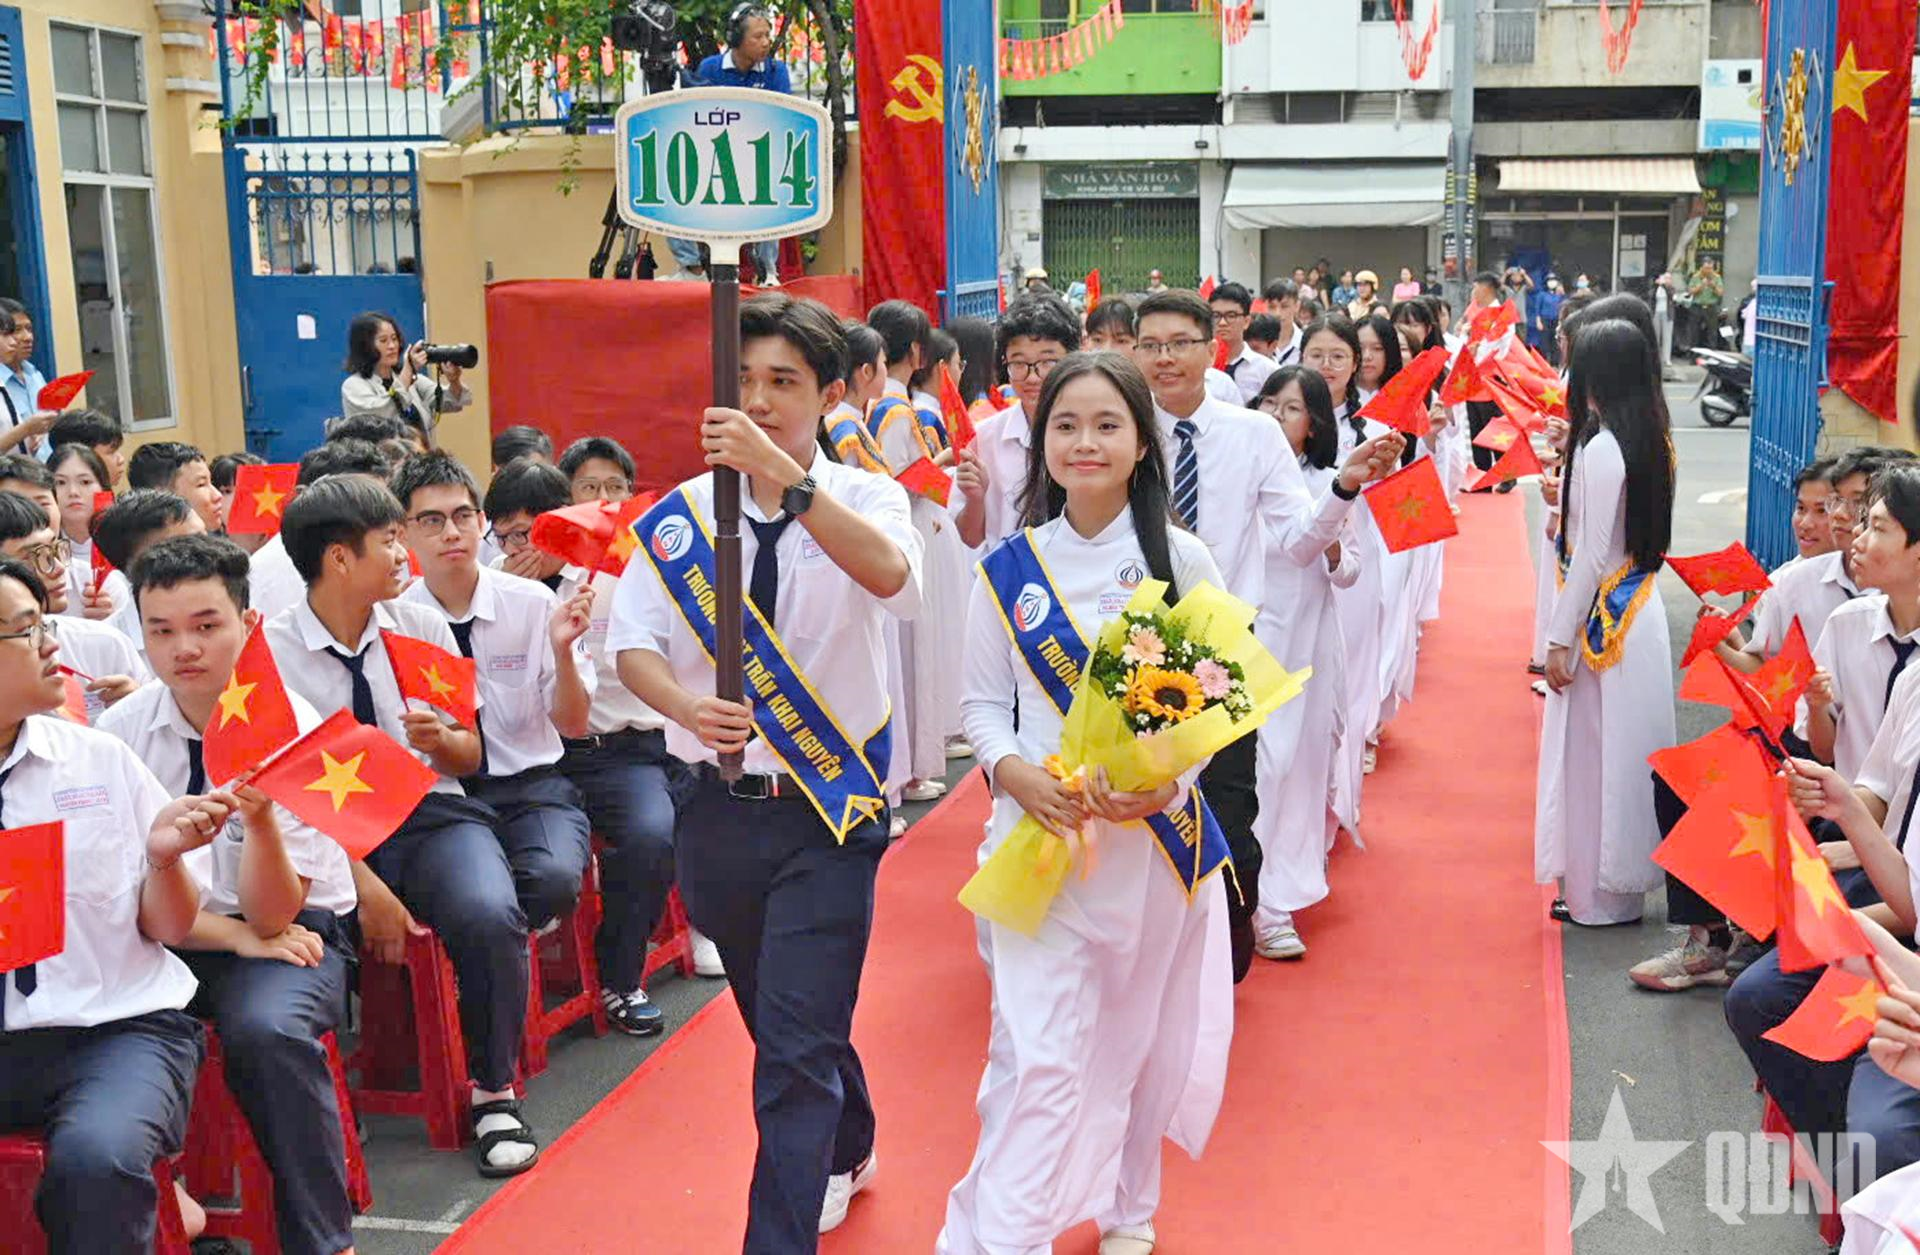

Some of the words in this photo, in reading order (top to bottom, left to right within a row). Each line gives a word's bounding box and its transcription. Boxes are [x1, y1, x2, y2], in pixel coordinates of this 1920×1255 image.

[695, 107, 741, 126] LỚP
[634, 129, 815, 206] 10A14
[767, 693, 803, 732] KHAI
[791, 726, 843, 782] NGUYÊN
